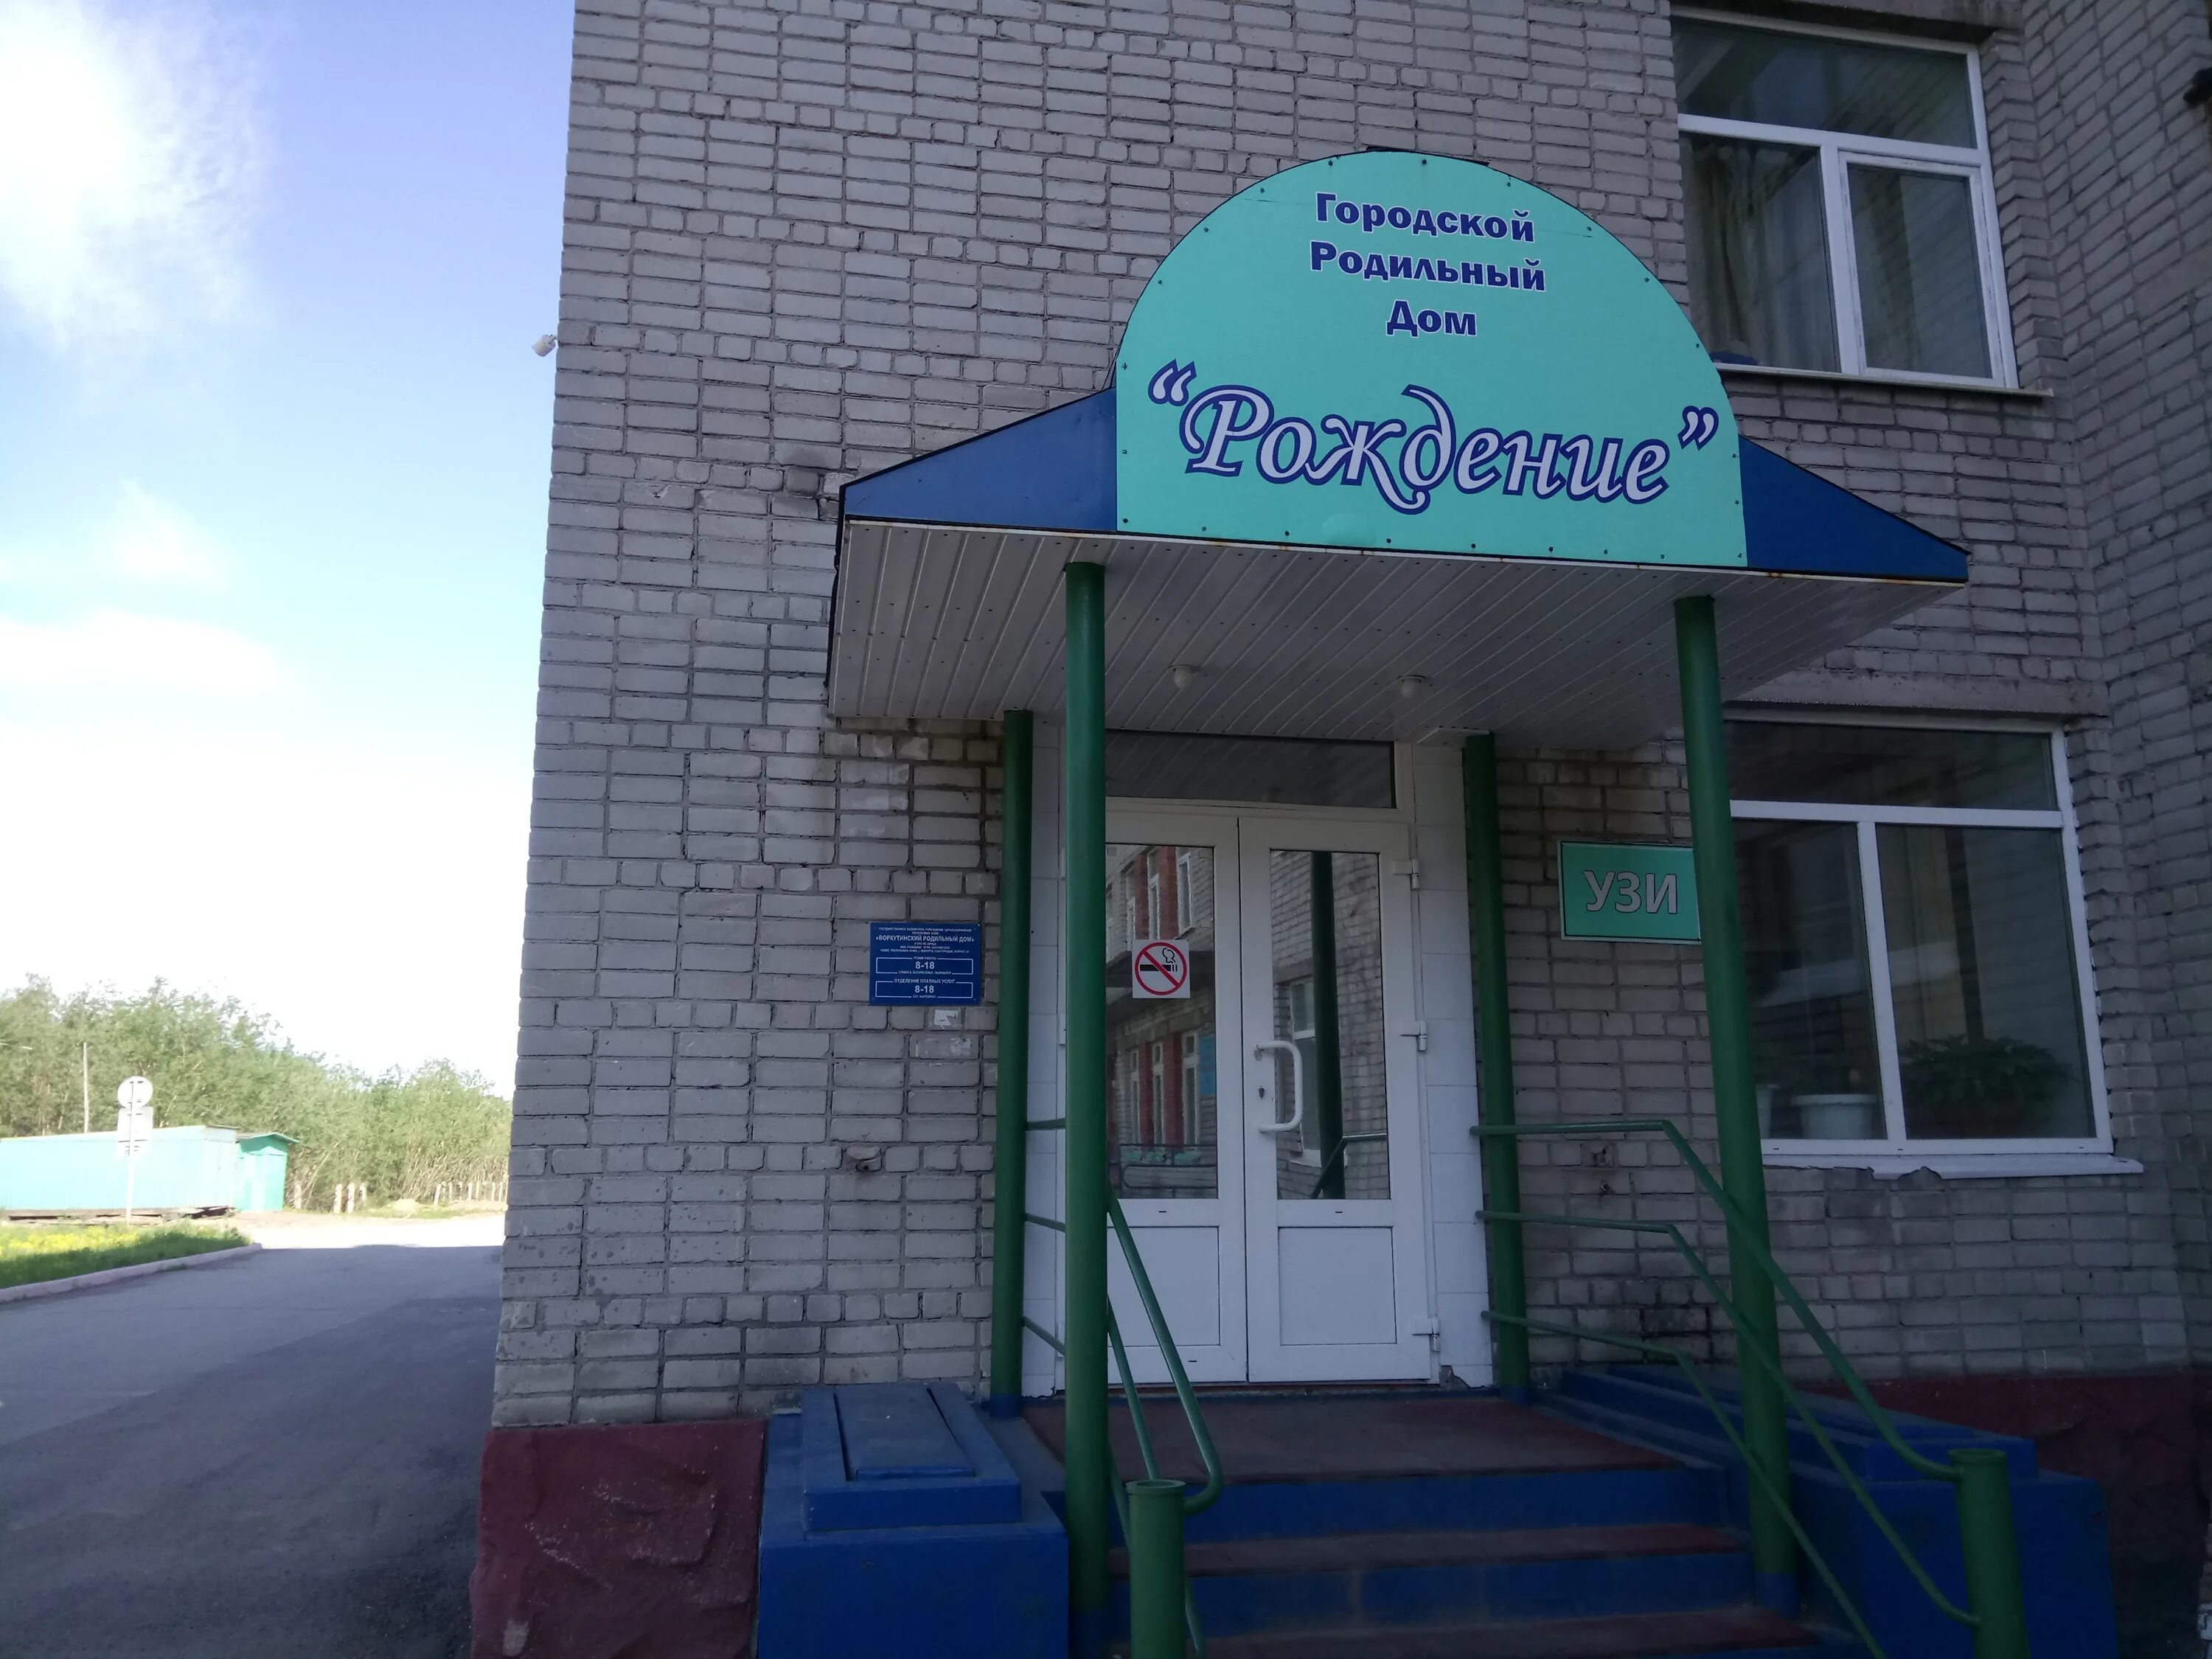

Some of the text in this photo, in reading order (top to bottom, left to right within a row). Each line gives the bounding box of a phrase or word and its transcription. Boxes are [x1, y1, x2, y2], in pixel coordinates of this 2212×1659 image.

[1315, 191, 1536, 244] Городской
[1310, 239, 1547, 292] Родильный
[1385, 299, 1478, 338] Дом
[1147, 358, 1719, 516] “Рождение”
[1582, 870, 1677, 914] УЗИ
[915, 961, 935, 970] 8-18
[914, 985, 934, 993] 8-18
